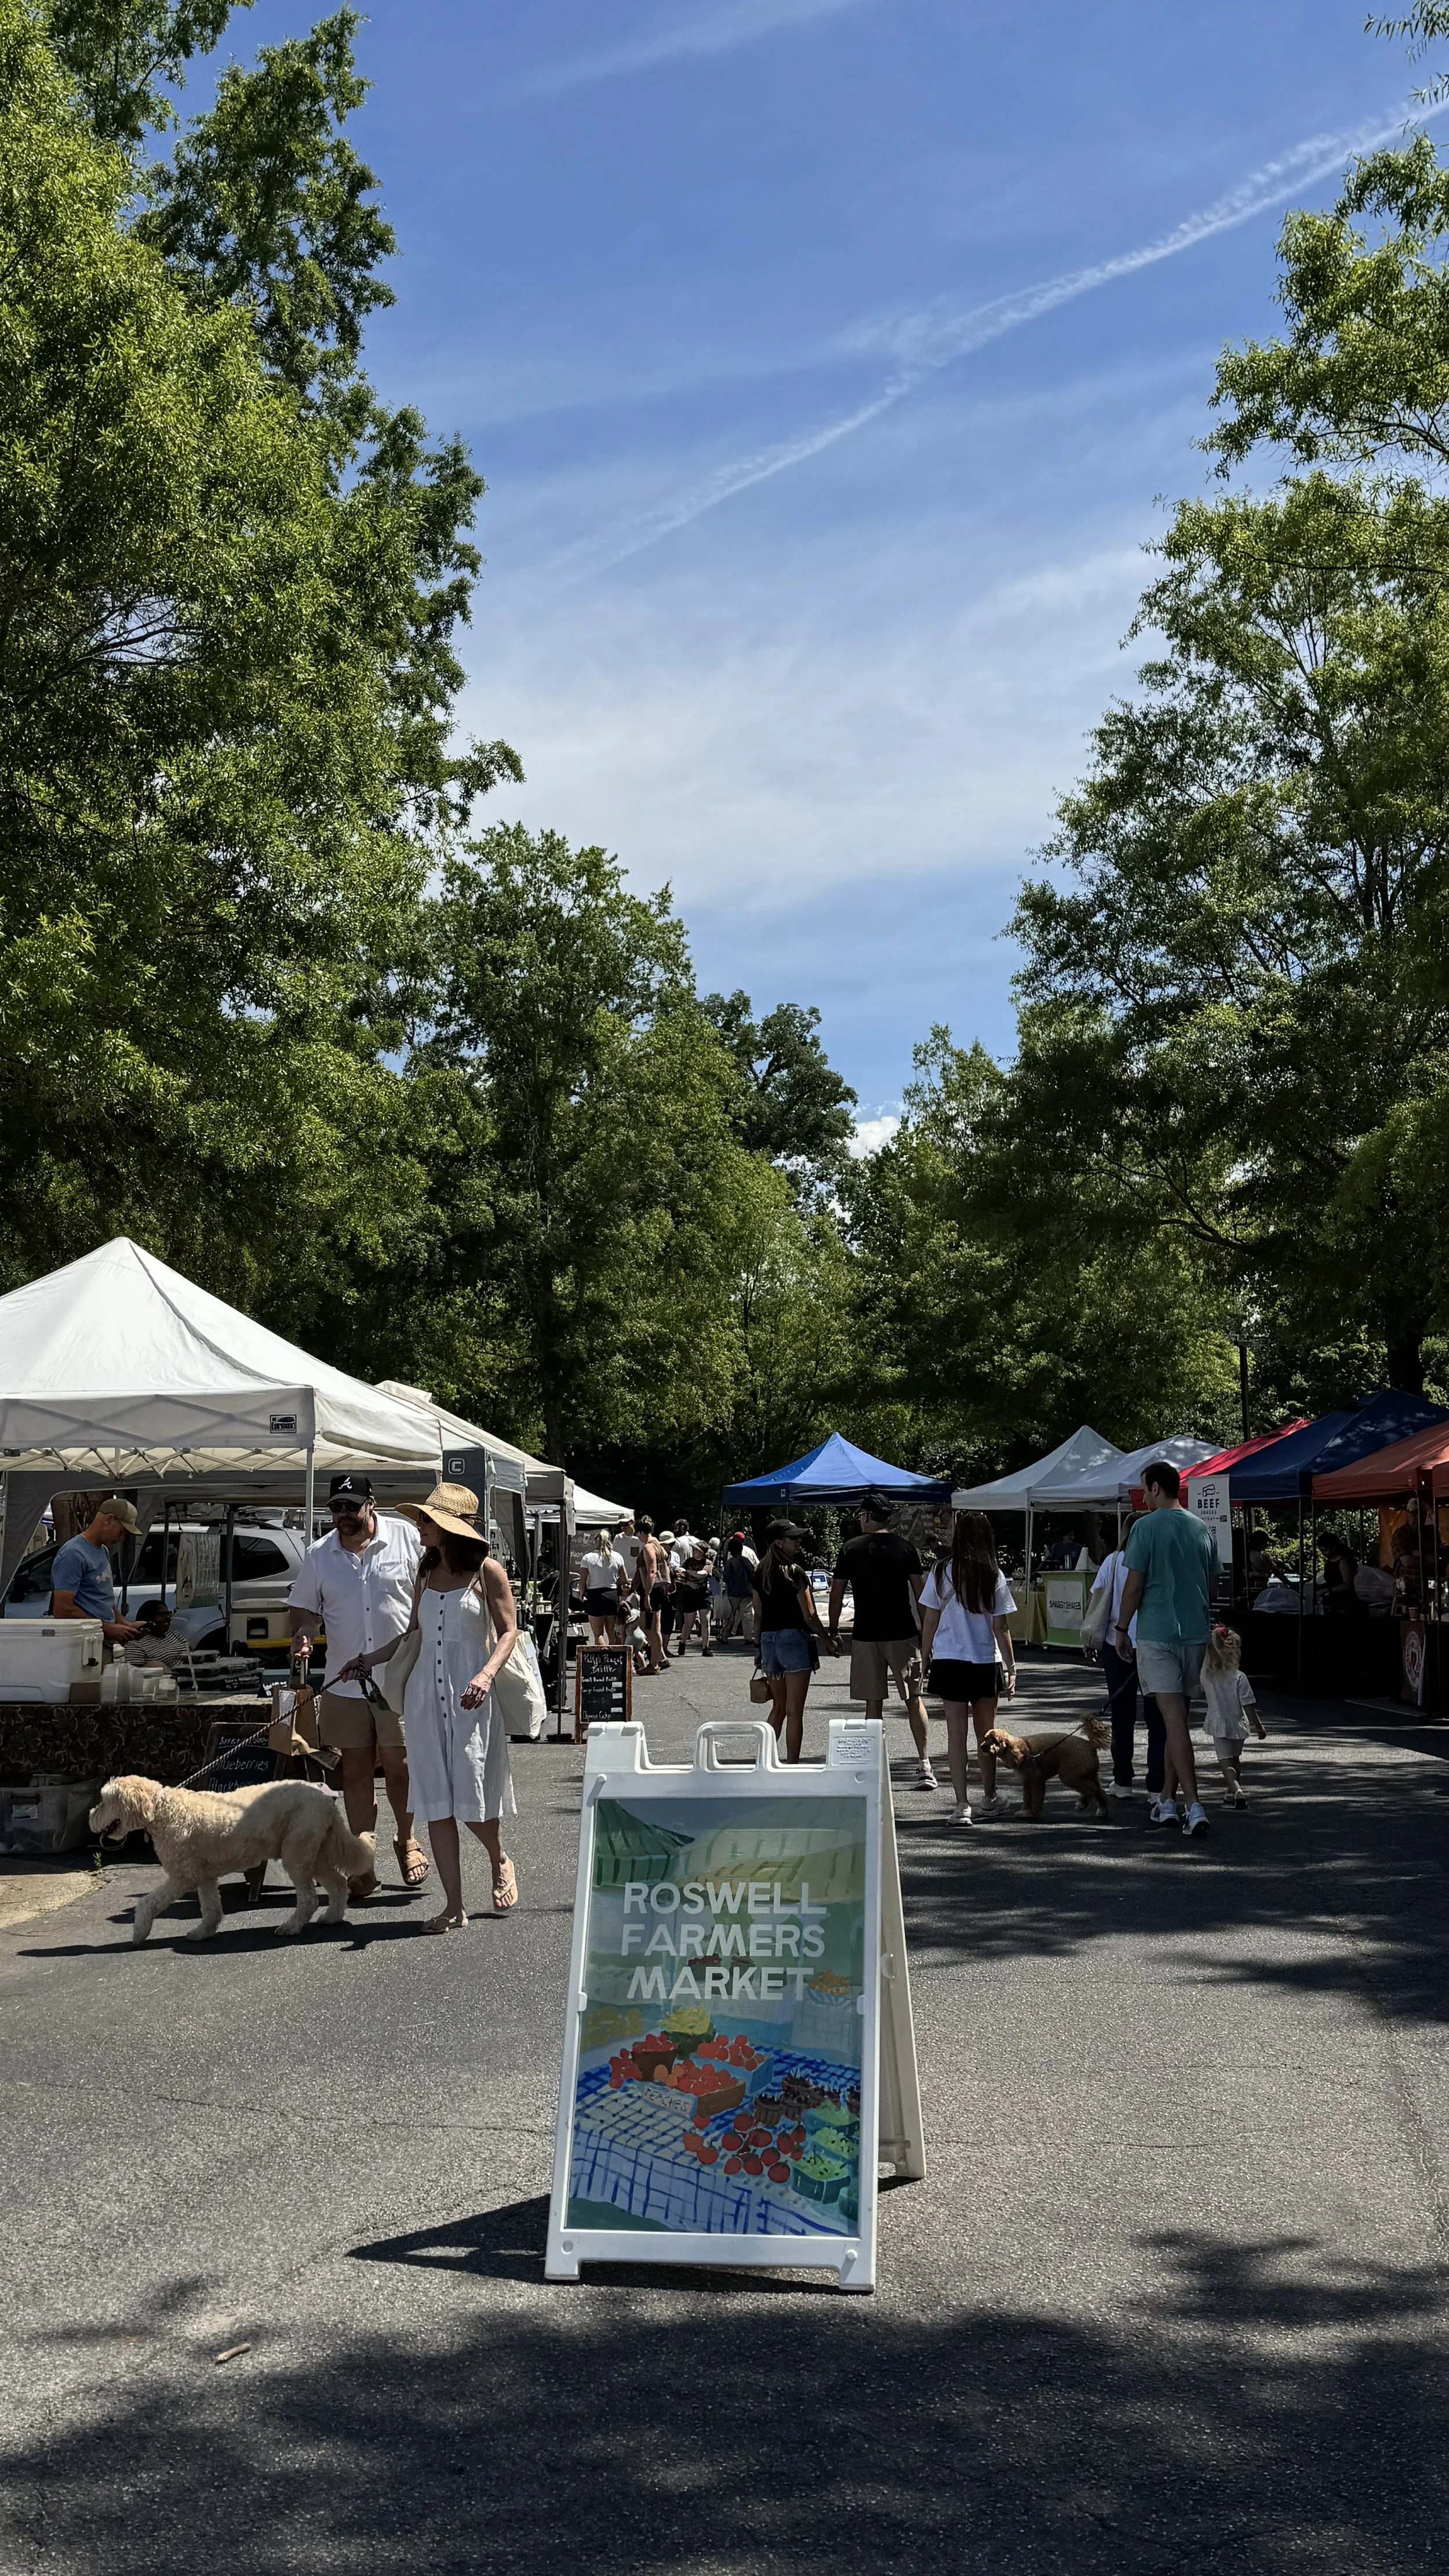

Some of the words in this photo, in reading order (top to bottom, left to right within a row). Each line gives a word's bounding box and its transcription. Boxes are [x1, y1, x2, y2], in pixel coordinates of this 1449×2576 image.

[1197, 1499, 1219, 1508] BEEF
[623, 1882, 827, 1914] ROSWELL
[621, 1923, 825, 1957] FARMERS
[627, 1966, 814, 2000] MARKET
[645, 2088, 690, 2112] PEACHES
